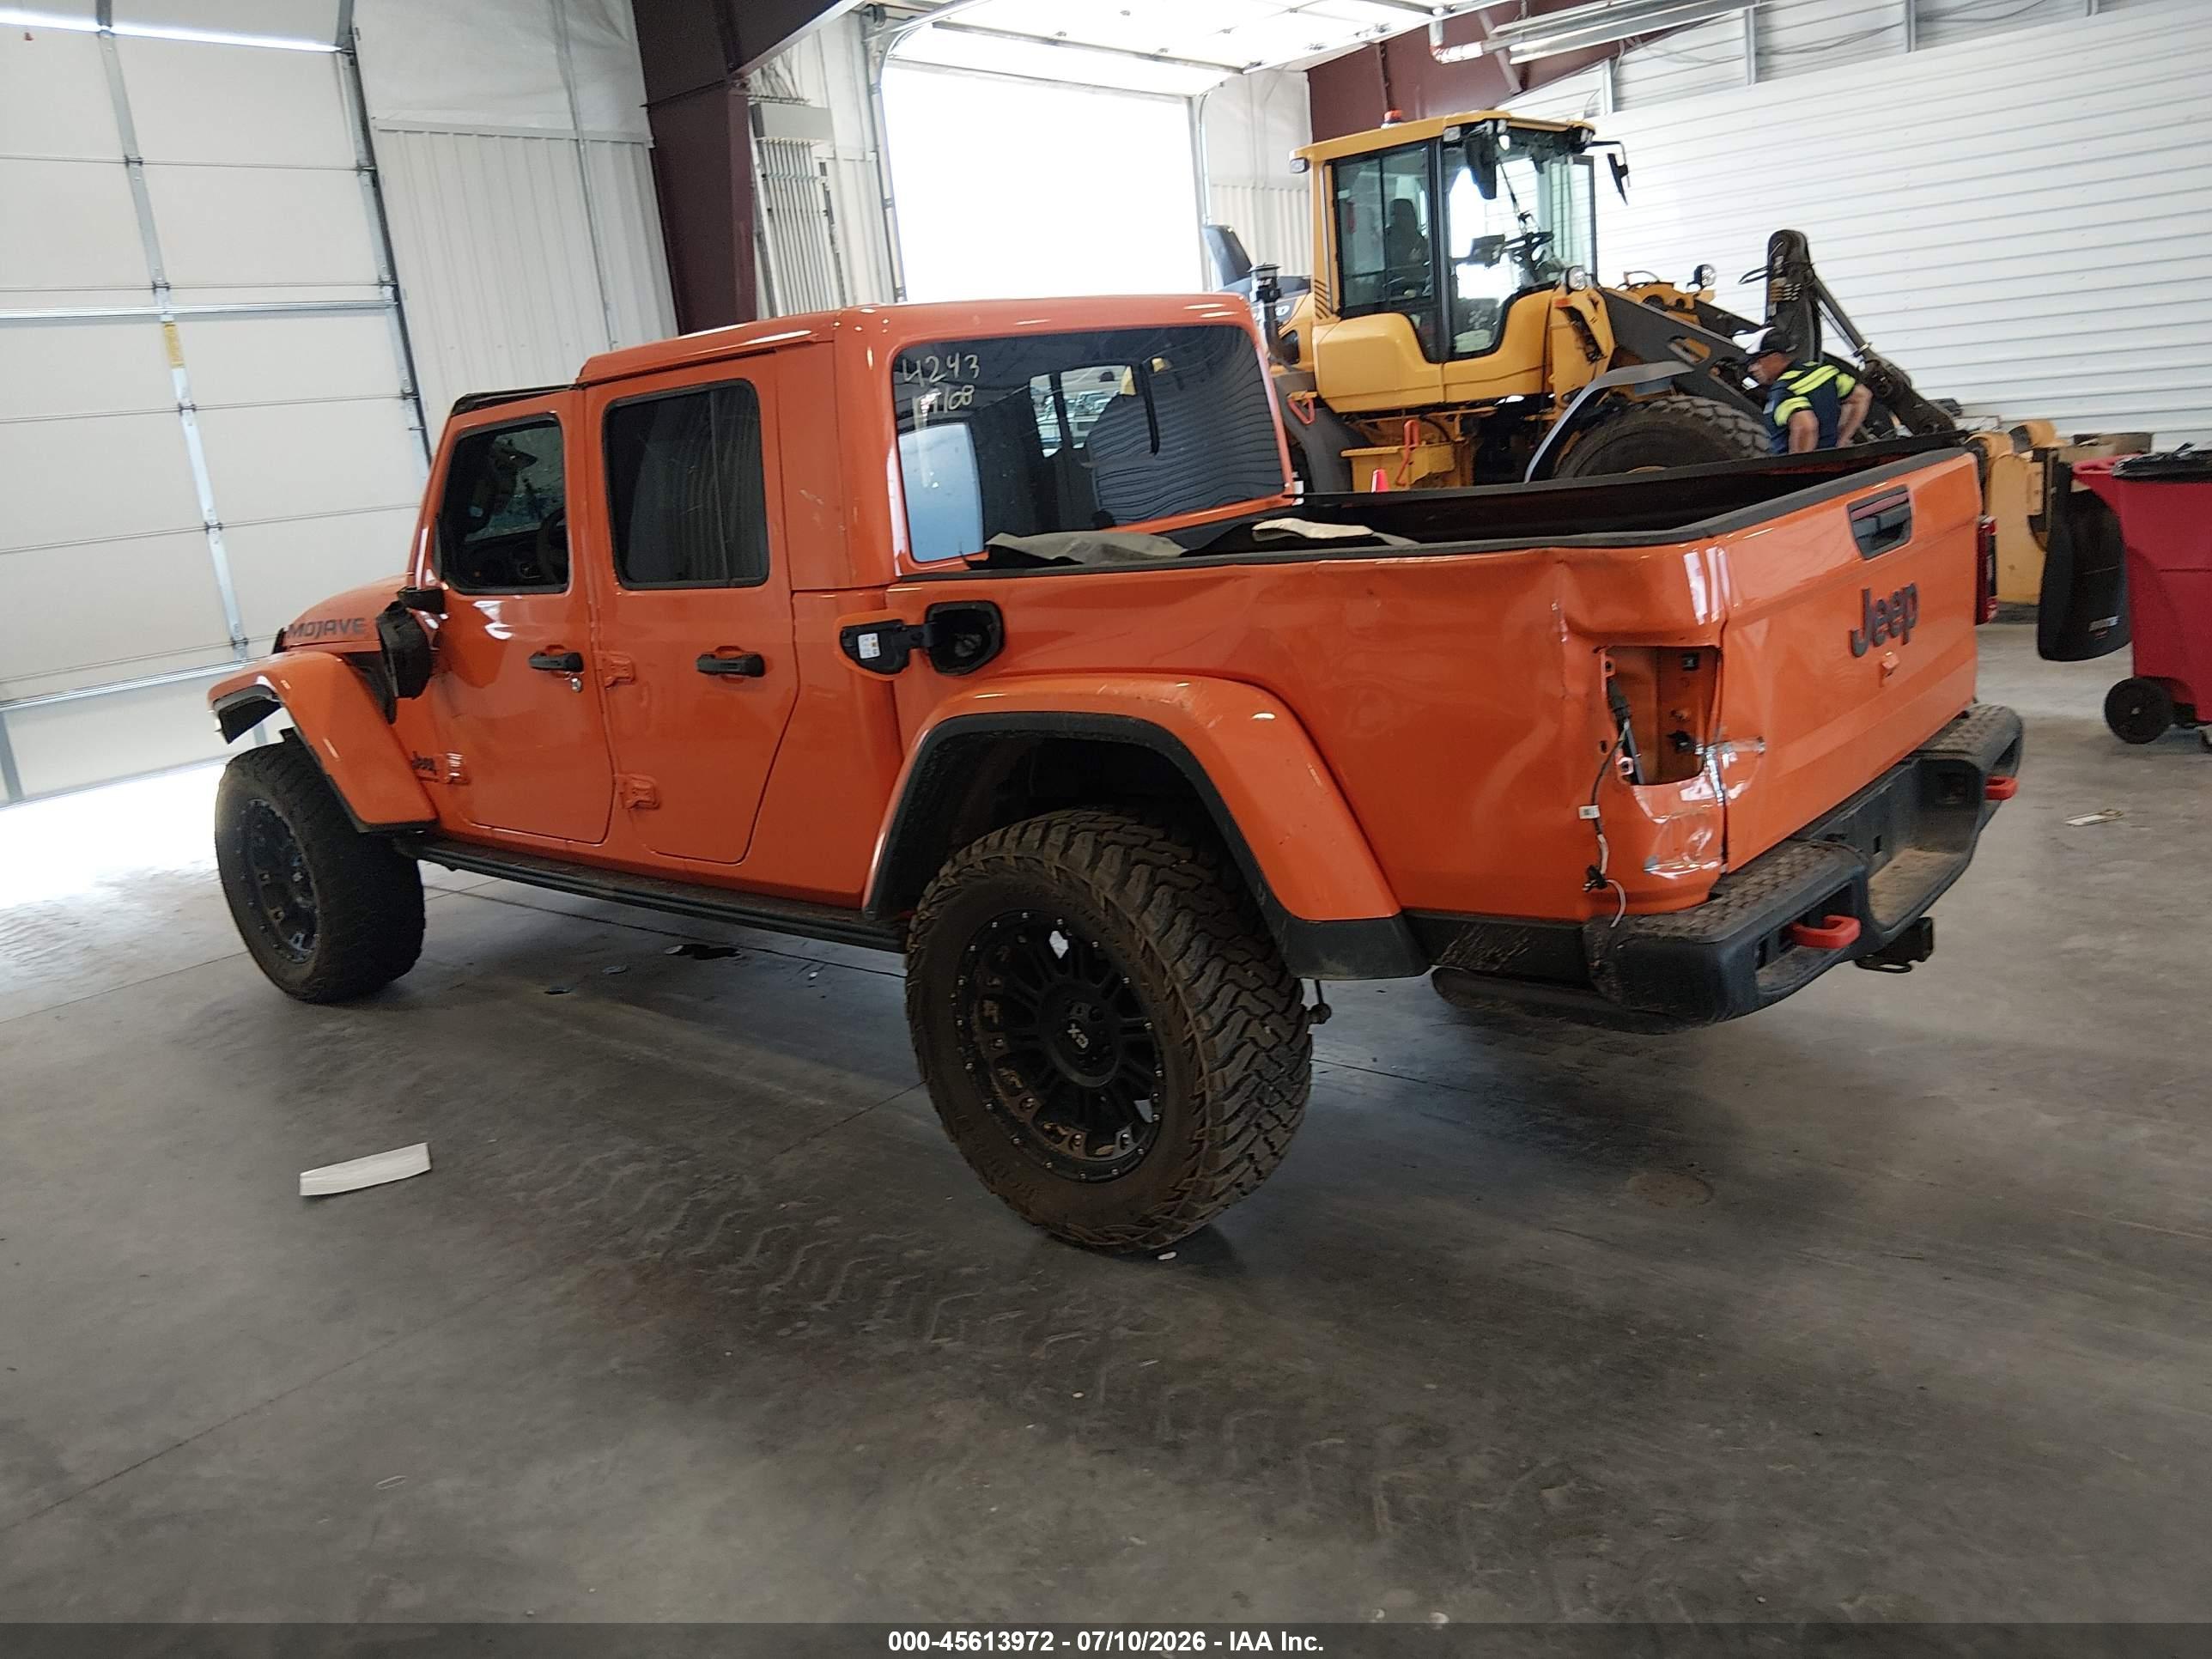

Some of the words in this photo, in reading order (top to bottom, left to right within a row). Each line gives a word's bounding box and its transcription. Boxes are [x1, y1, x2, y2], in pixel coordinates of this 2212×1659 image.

[902, 352, 980, 387] 4243
[289, 617, 365, 639] MOJAVE
[1848, 581, 1917, 659] Jeep
